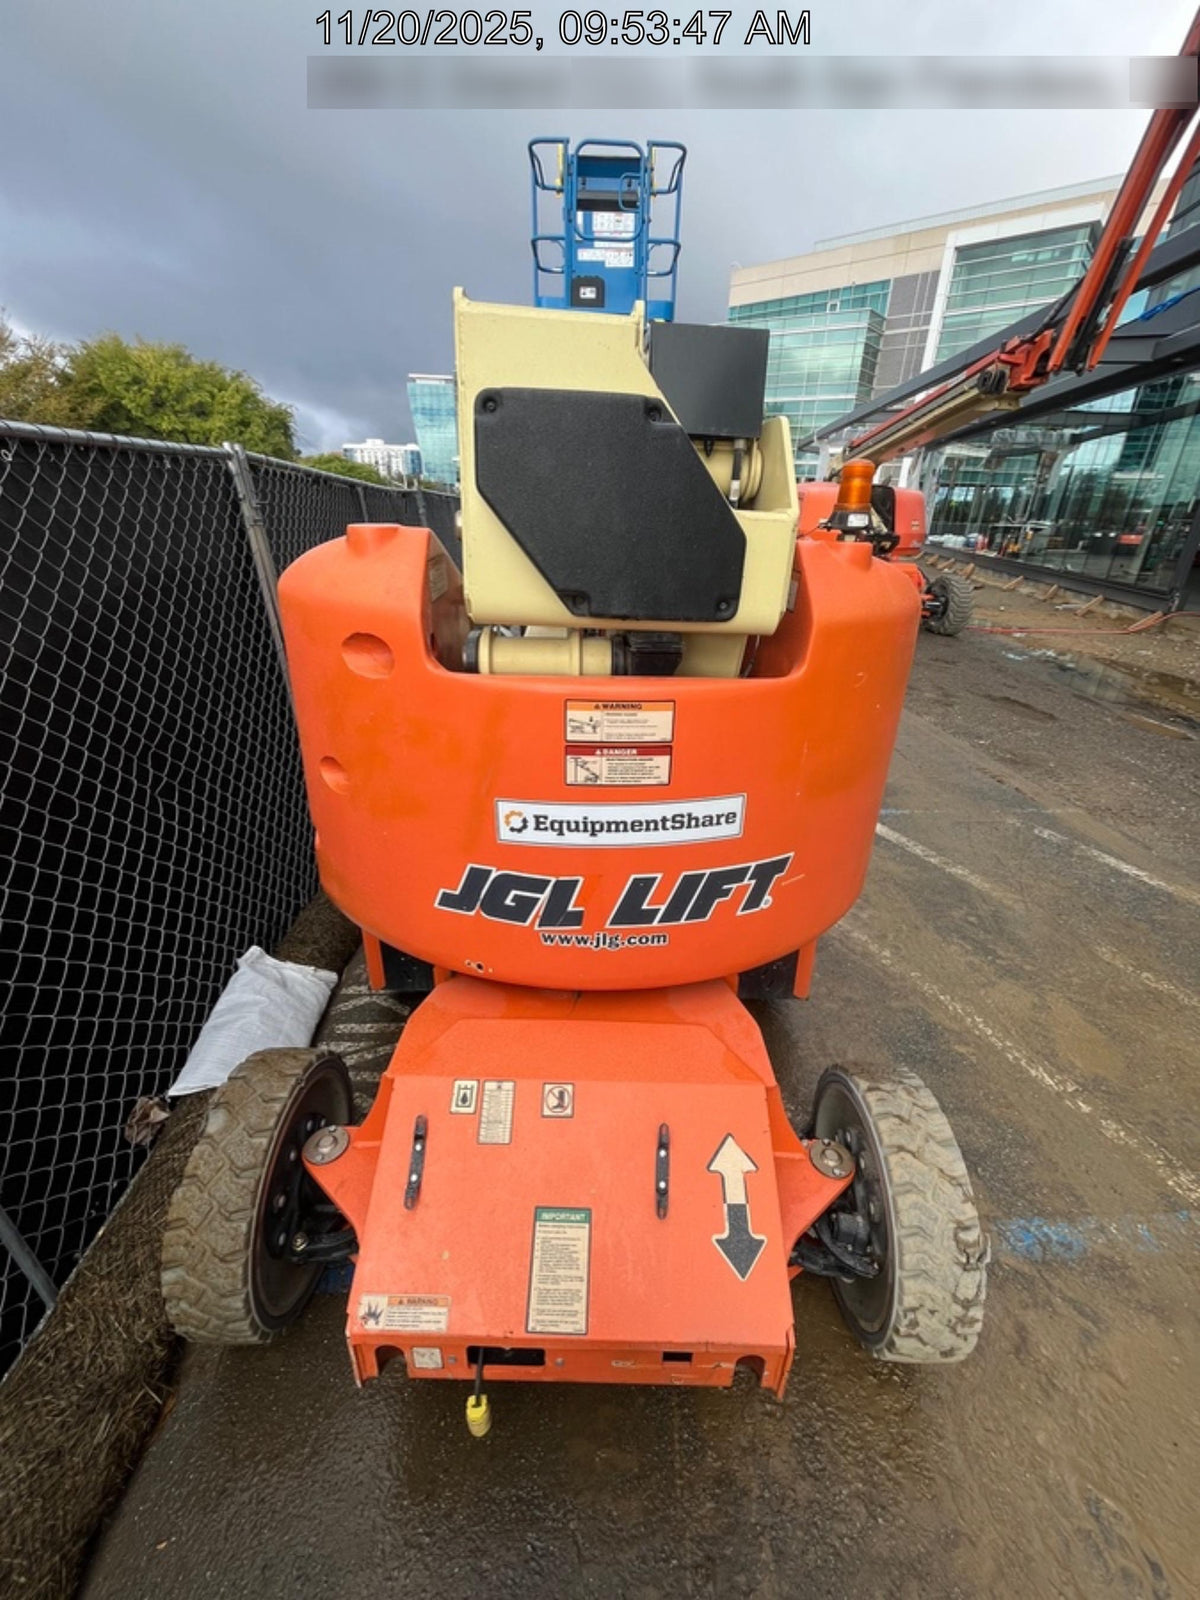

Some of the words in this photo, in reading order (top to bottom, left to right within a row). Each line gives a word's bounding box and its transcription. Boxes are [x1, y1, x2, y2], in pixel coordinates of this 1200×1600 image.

[602, 748, 638, 756] DANGER
[532, 810, 738, 837] EquipmentShare
[434, 863, 585, 930] JGL
[604, 852, 795, 928] LIFT
[540, 931, 669, 950] www.jlg.com
